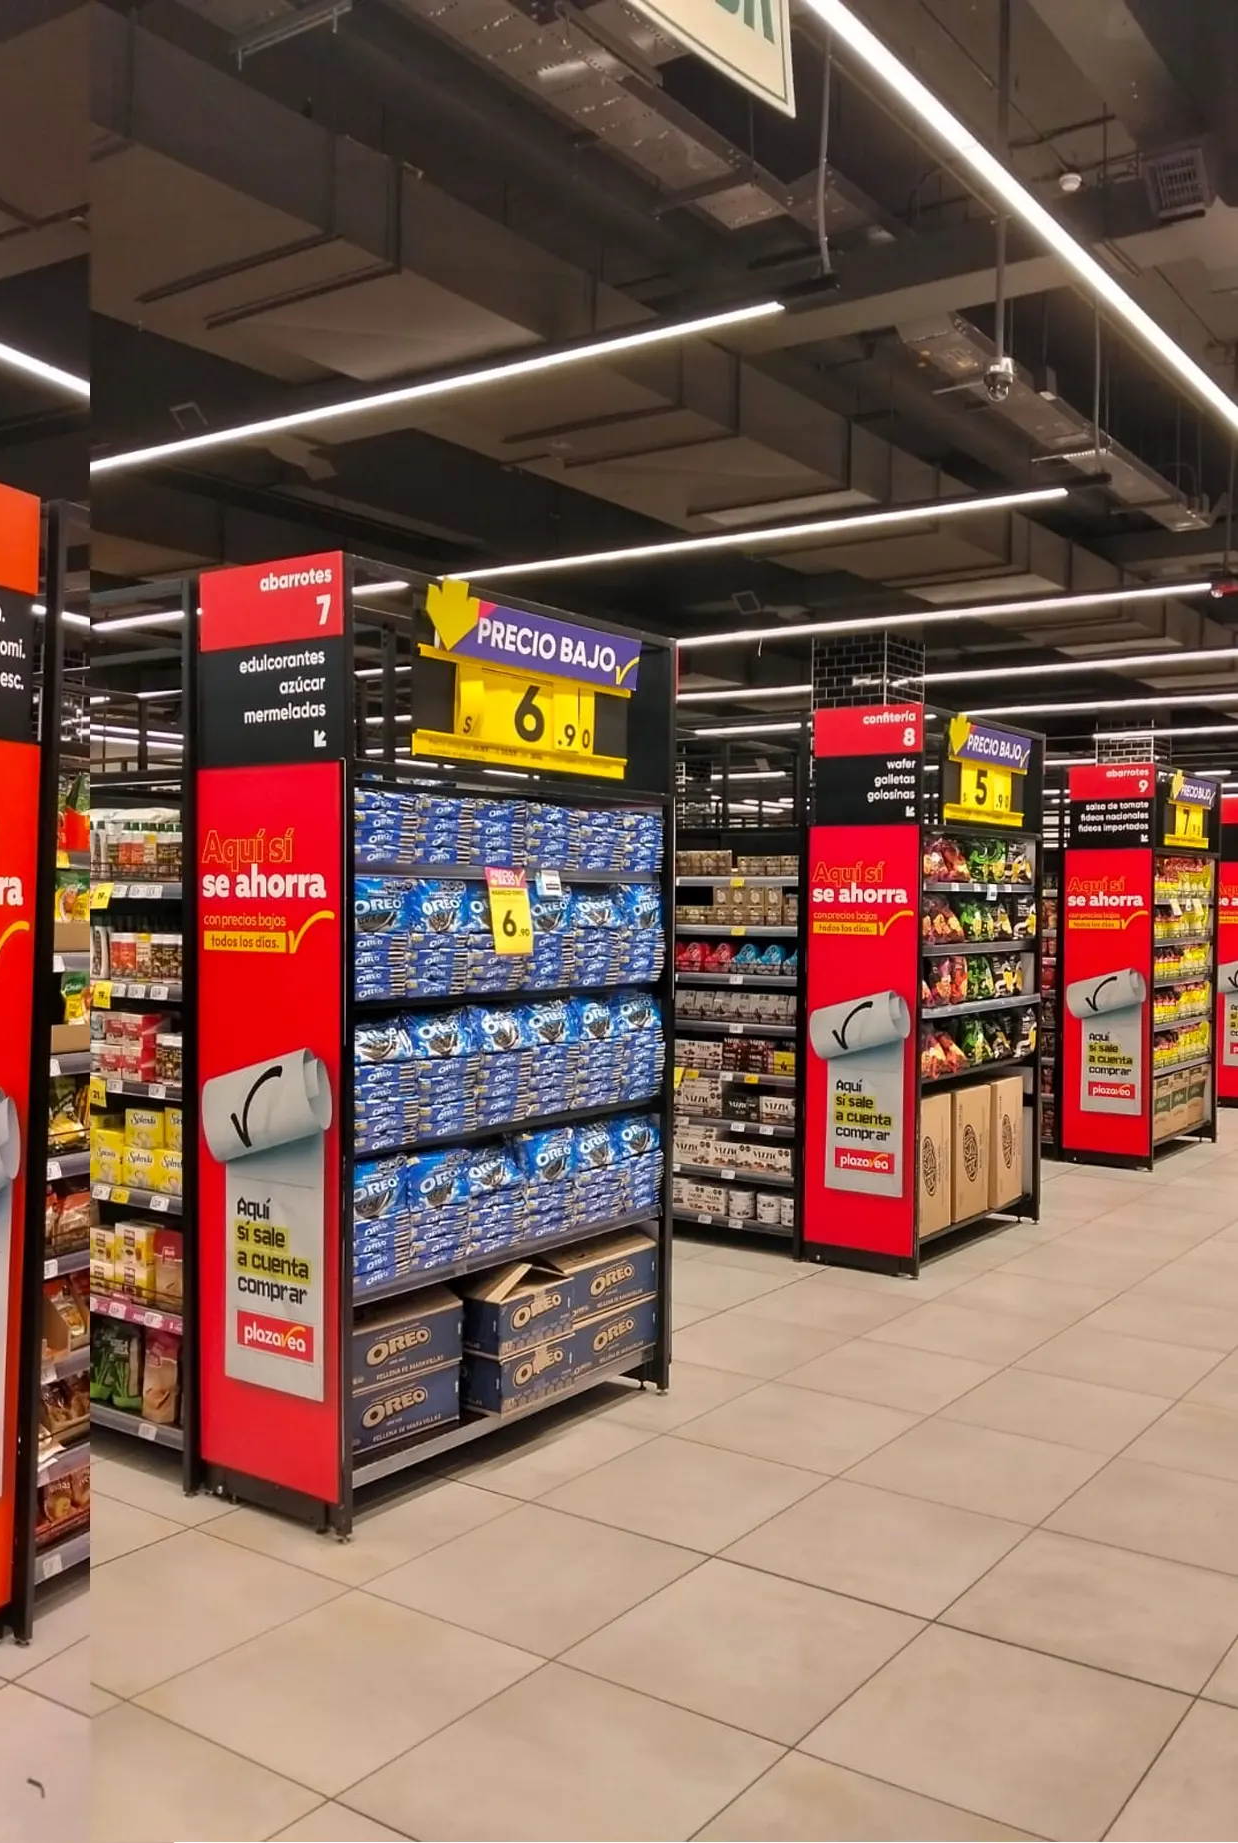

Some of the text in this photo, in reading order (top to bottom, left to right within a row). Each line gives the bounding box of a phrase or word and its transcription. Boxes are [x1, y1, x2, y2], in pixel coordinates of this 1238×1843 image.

[260, 568, 332, 591] abarrotes
[316, 594, 331, 625] 7
[477, 617, 616, 672] PRECIO BAJO
[239, 650, 325, 673] edulcorantes
[280, 676, 325, 694] azúcar
[244, 702, 326, 724] mermeladas
[863, 710, 916, 725] confitería
[903, 727, 915, 746] 8
[967, 734, 1022, 760] PRECIO BAJO
[887, 759, 916, 770] wafer
[874, 774, 915, 788] galletas
[1106, 769, 1149, 778] abarrotes
[1139, 780, 1148, 793] 9
[867, 789, 915, 802] golosinas
[1086, 803, 1105, 811] salsa
[1107, 802, 1118, 810] de
[1081, 811, 1149, 821] fideos nacionales
[1078, 823, 1149, 832] fideos importados
[201, 827, 294, 872] Aquí sí
[202, 863, 326, 898] se ahorra
[812, 861, 885, 888] Aquí sí
[813, 881, 908, 904] se ahorra
[1068, 891, 1144, 906] se ahorra
[355, 898, 402, 915] OREO
[422, 898, 460, 915] OREO
[204, 912, 286, 930] con precios bajos
[211, 934, 237, 947] todos
[239, 936, 253, 948] los
[1089, 1032, 1110, 1042] Aquí
[1099, 1043, 1118, 1052] sale
[1097, 1055, 1133, 1064] cuenta
[1089, 1066, 1131, 1077] comprar
[836, 1079, 862, 1093] Aquí
[836, 1093, 873, 1109] sí sale
[130, 1113, 156, 1126] Splenda
[836, 1111, 892, 1126] a cuenta
[836, 1126, 890, 1141] comprar
[536, 1146, 571, 1167] OREO
[237, 1197, 271, 1220] Aquí
[237, 1221, 285, 1248] sí sale
[237, 1251, 309, 1279] a cuenta
[591, 1266, 633, 1296] OREO
[237, 1276, 307, 1304] comprar
[593, 1319, 634, 1351] OREO
[366, 1329, 429, 1366] OREO
[362, 1388, 426, 1428] OREO
